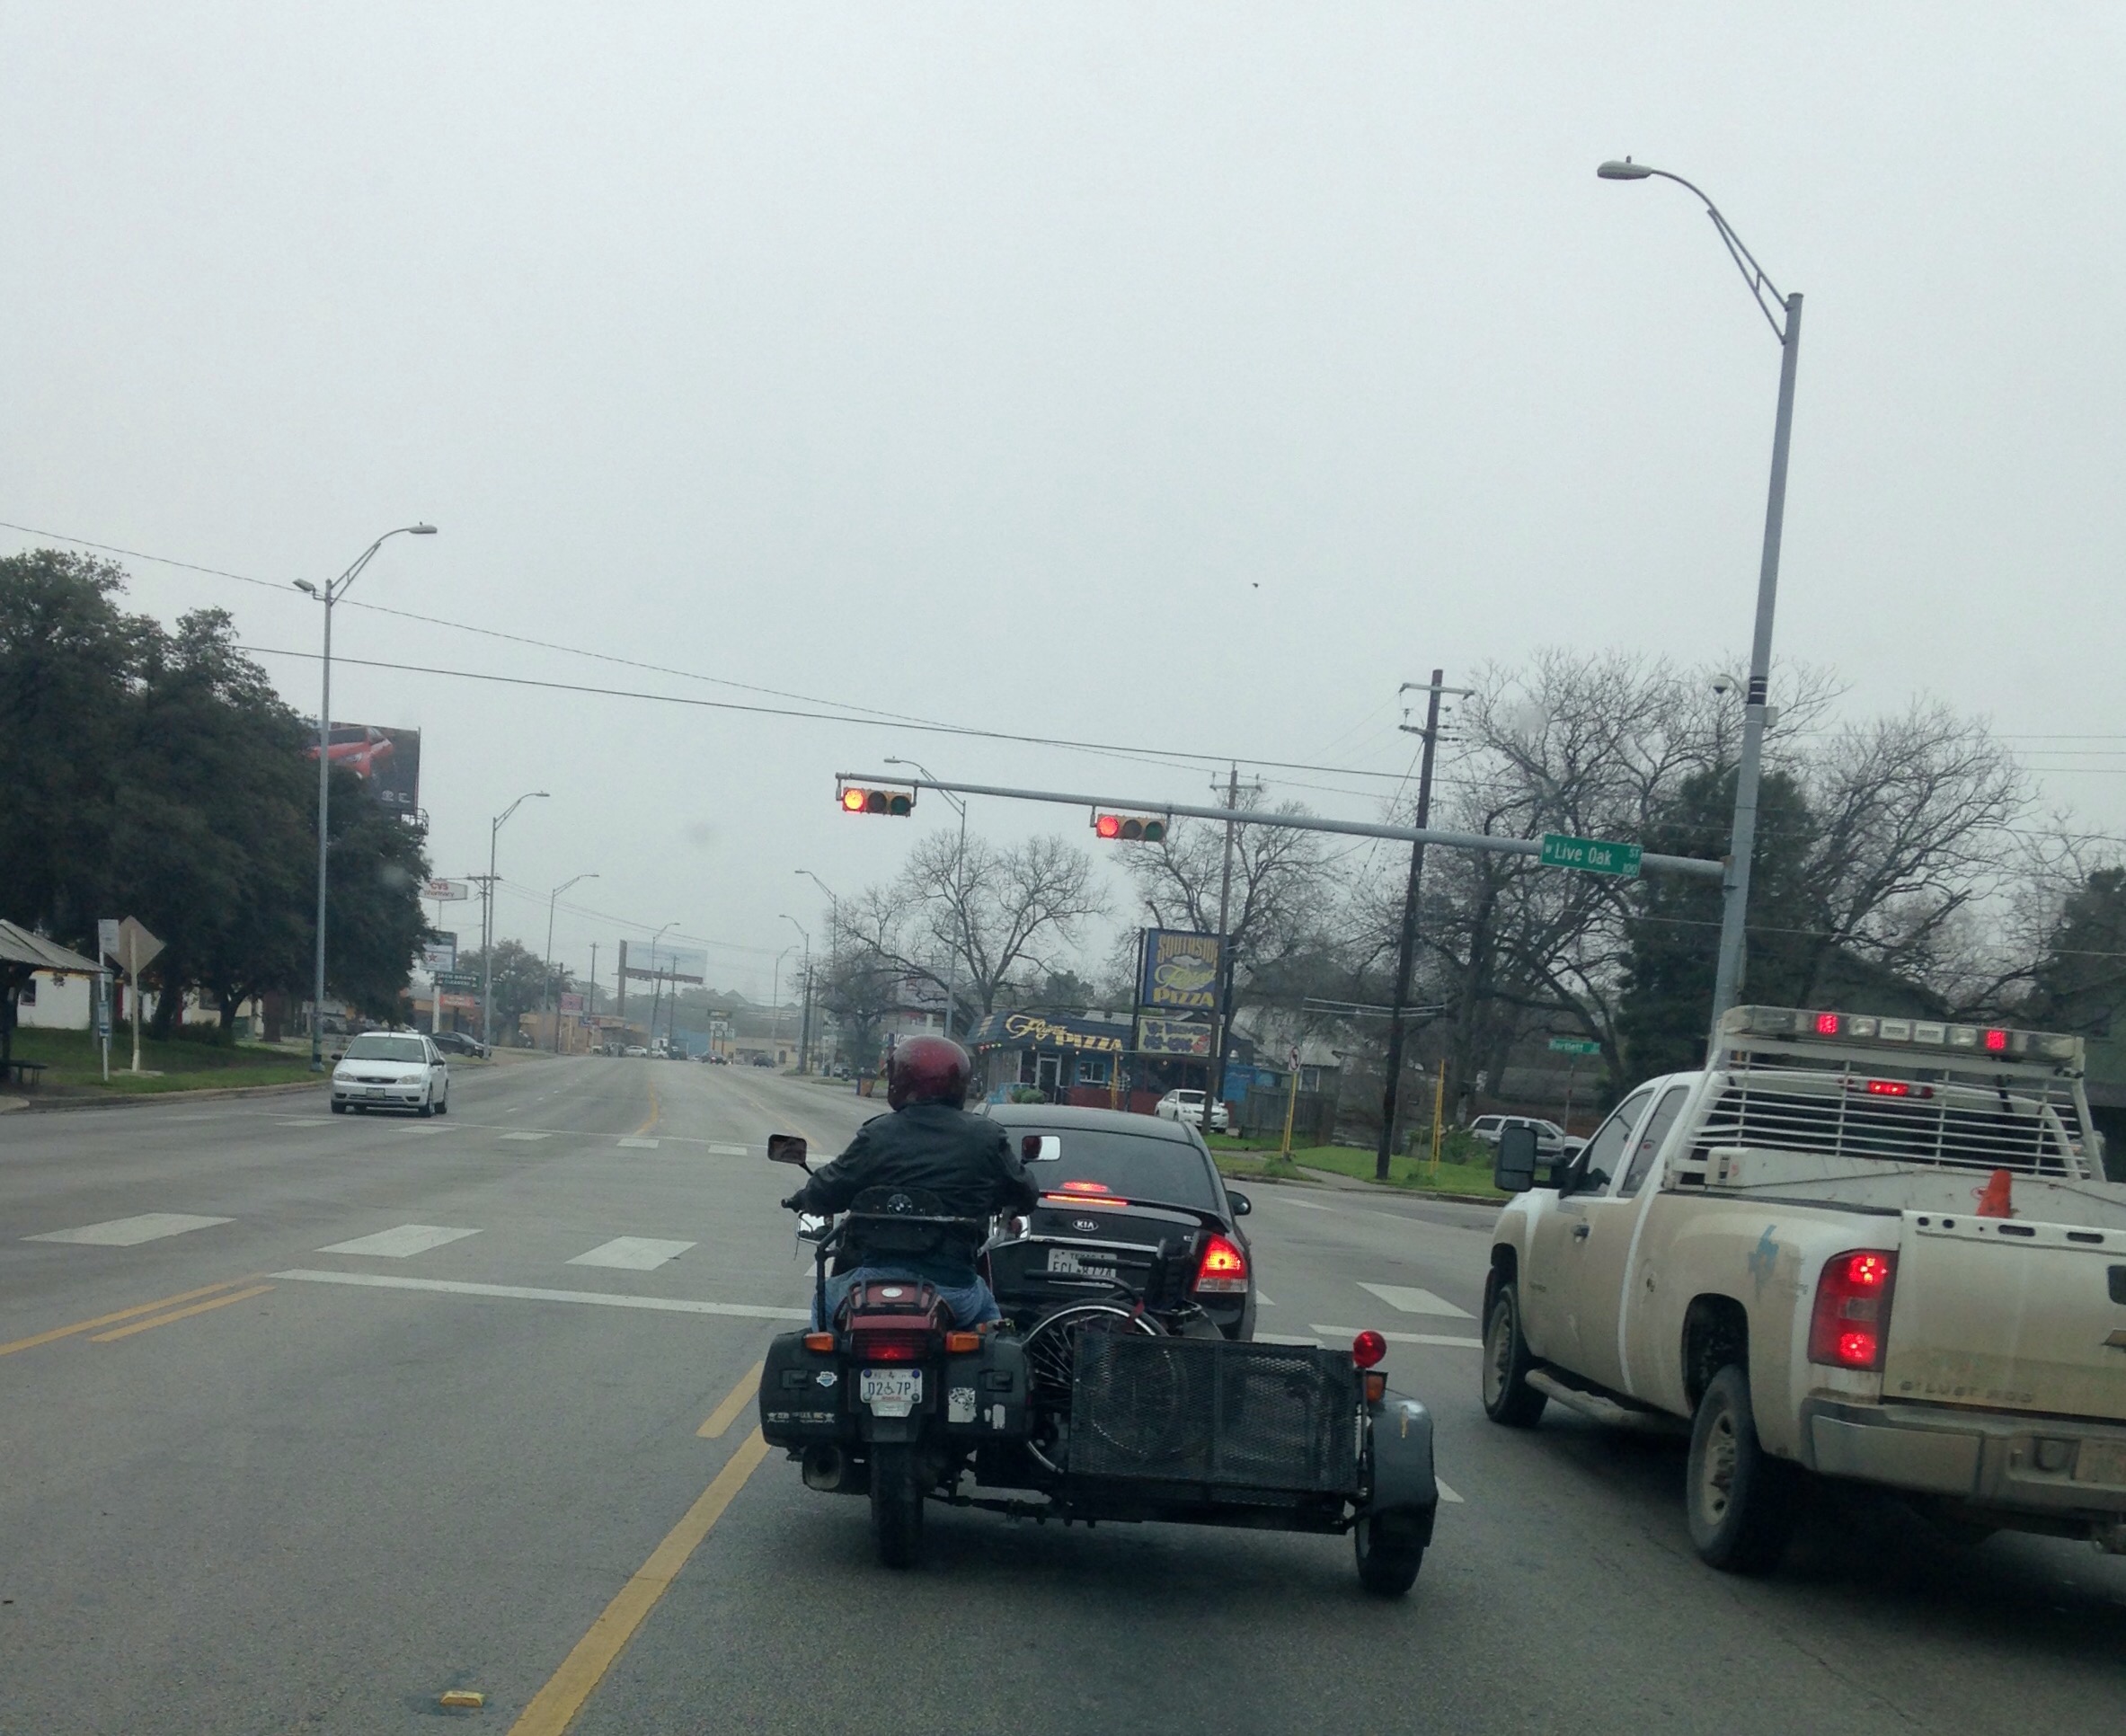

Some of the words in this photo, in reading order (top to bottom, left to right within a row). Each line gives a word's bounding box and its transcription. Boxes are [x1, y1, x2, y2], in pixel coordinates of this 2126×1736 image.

[1555, 843, 1583, 863] Live
[1588, 846, 1613, 865] Oak
[1628, 847, 1640, 859] ST
[431, 881, 448, 890] CVS
[1153, 988, 1215, 1007] PIZZA
[1055, 1032, 1123, 1051] PIZZA
[1077, 1220, 1094, 1229] KIA
